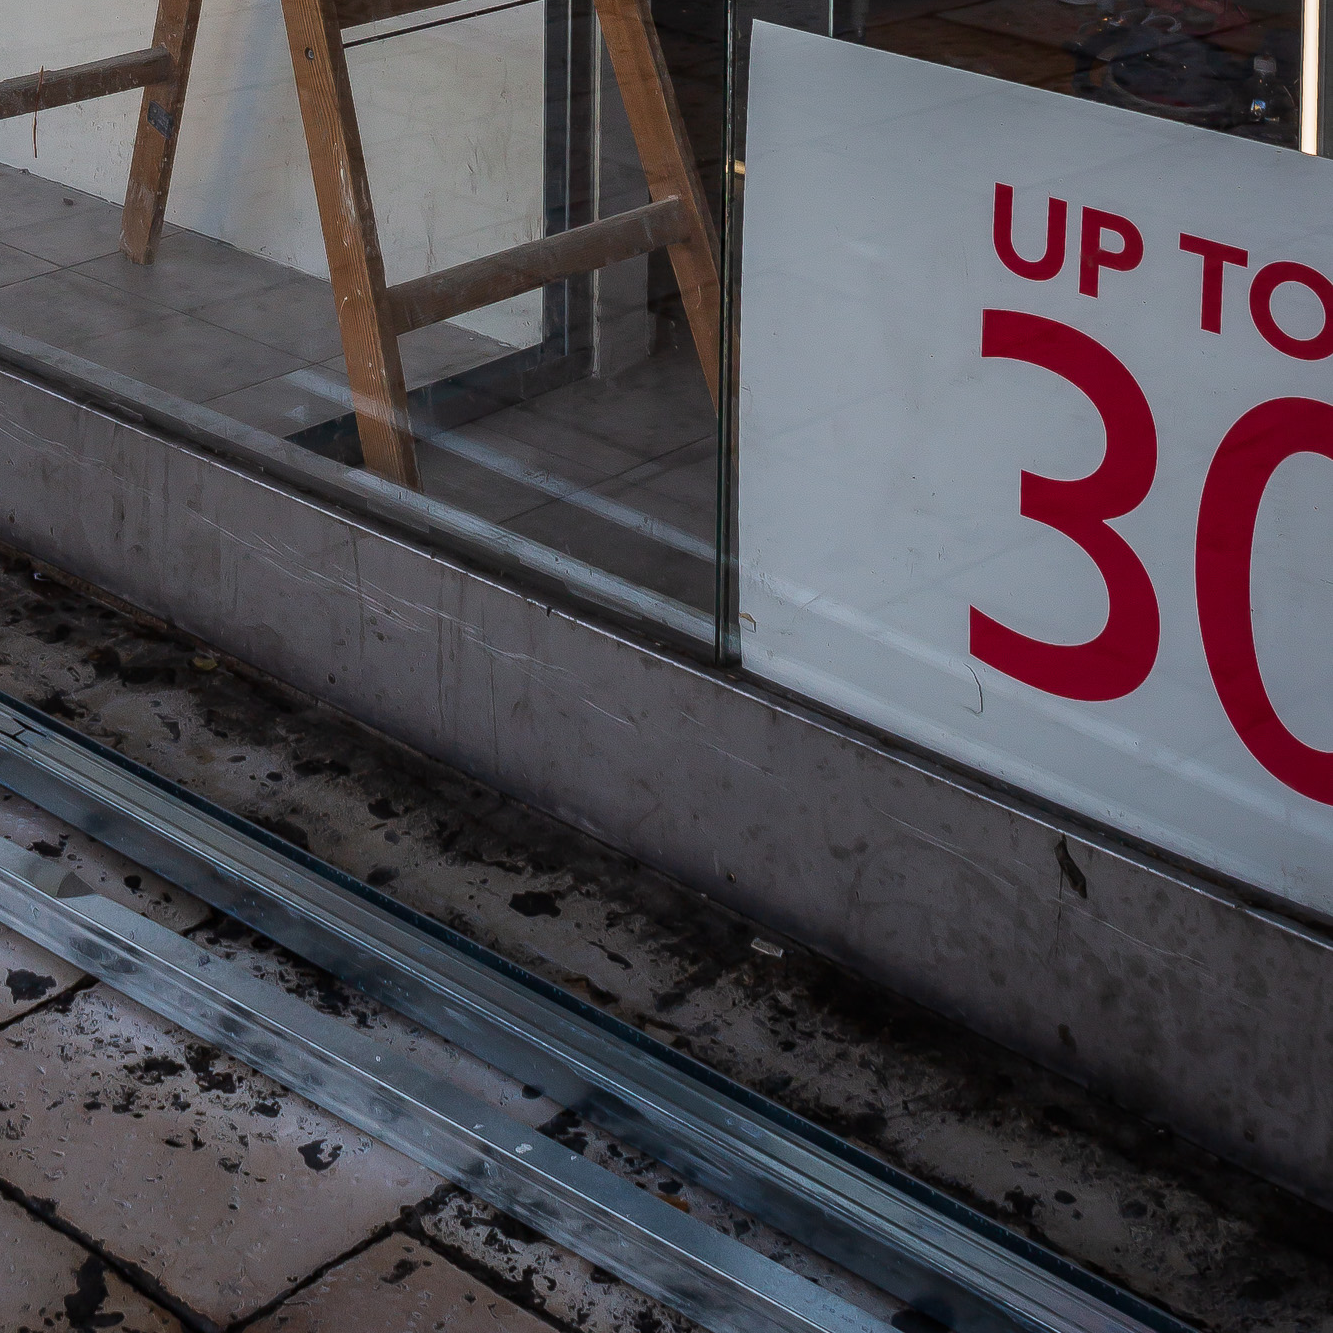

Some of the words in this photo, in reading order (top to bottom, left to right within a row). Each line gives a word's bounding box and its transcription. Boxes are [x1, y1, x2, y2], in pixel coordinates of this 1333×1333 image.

[994, 184, 1143, 297] UP
[1180, 234, 1333, 360] TO
[970, 310, 1333, 805] 30
